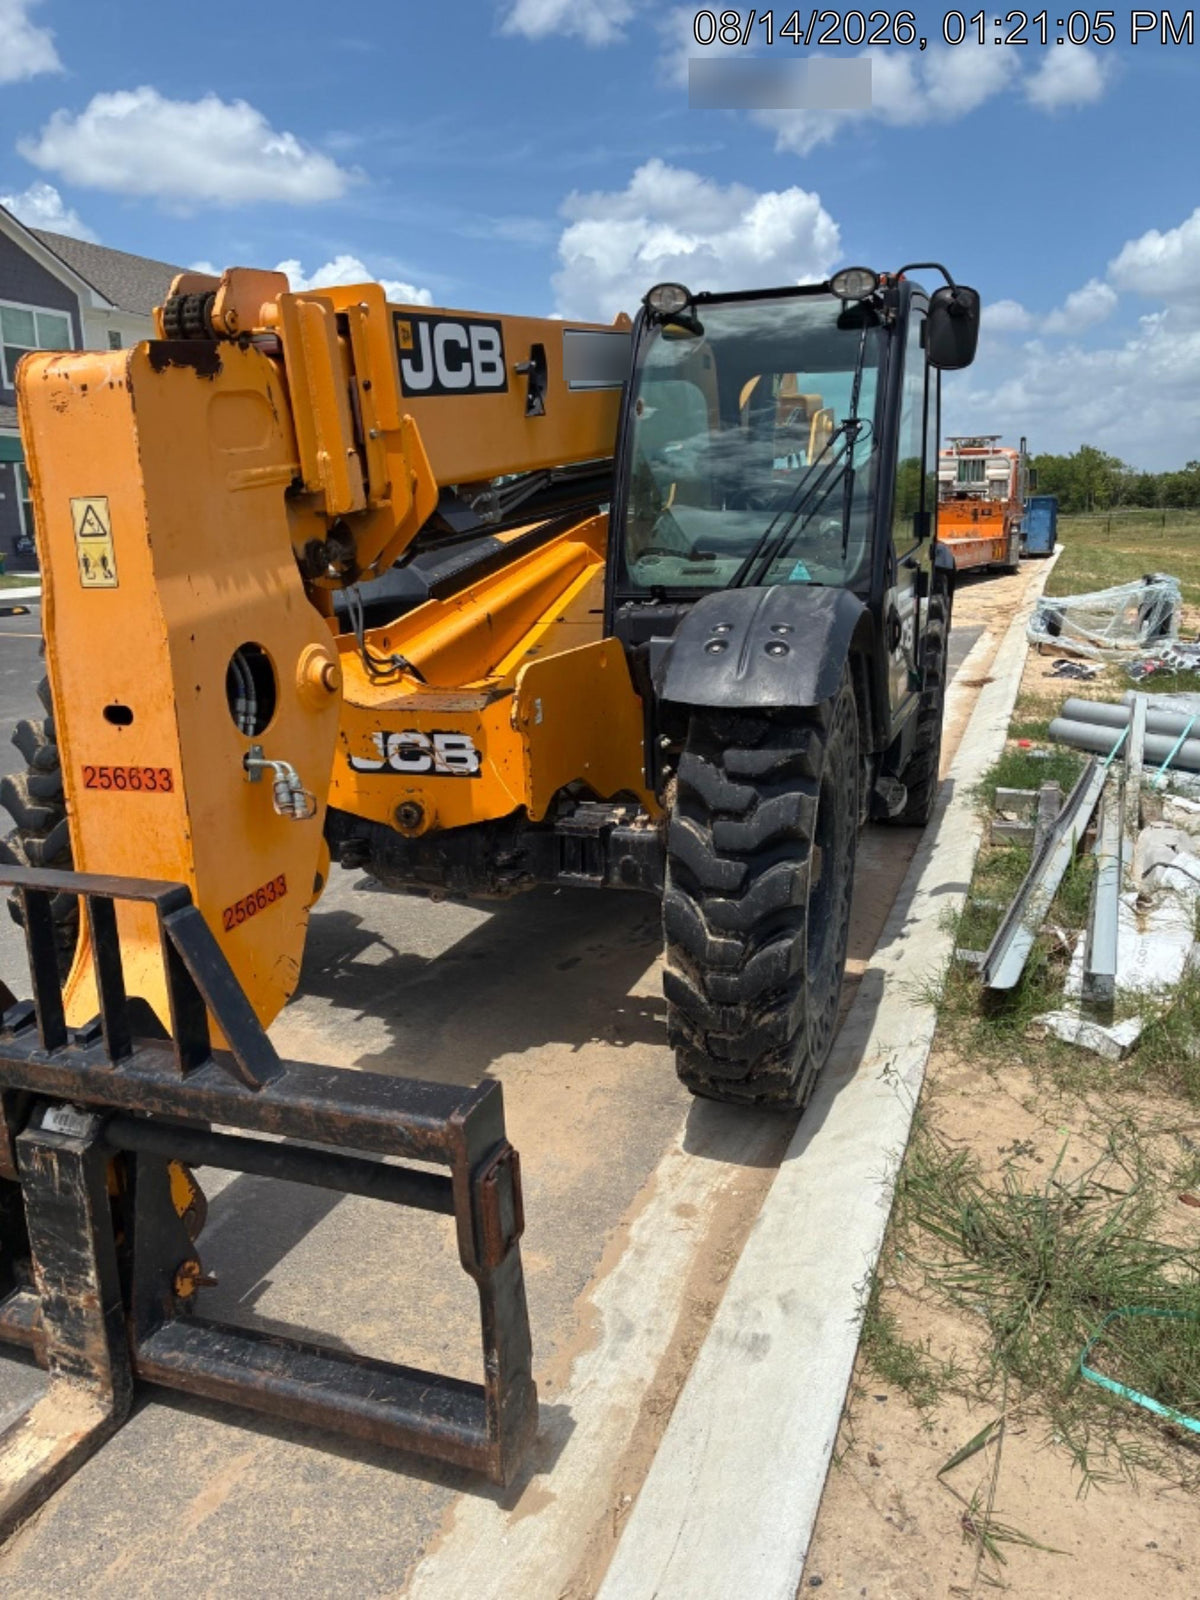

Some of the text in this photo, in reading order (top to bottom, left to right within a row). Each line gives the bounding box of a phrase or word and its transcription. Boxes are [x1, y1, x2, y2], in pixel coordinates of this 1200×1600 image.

[401, 321, 505, 390] JCB
[84, 766, 173, 792] 256633
[223, 874, 287, 932] 256633
